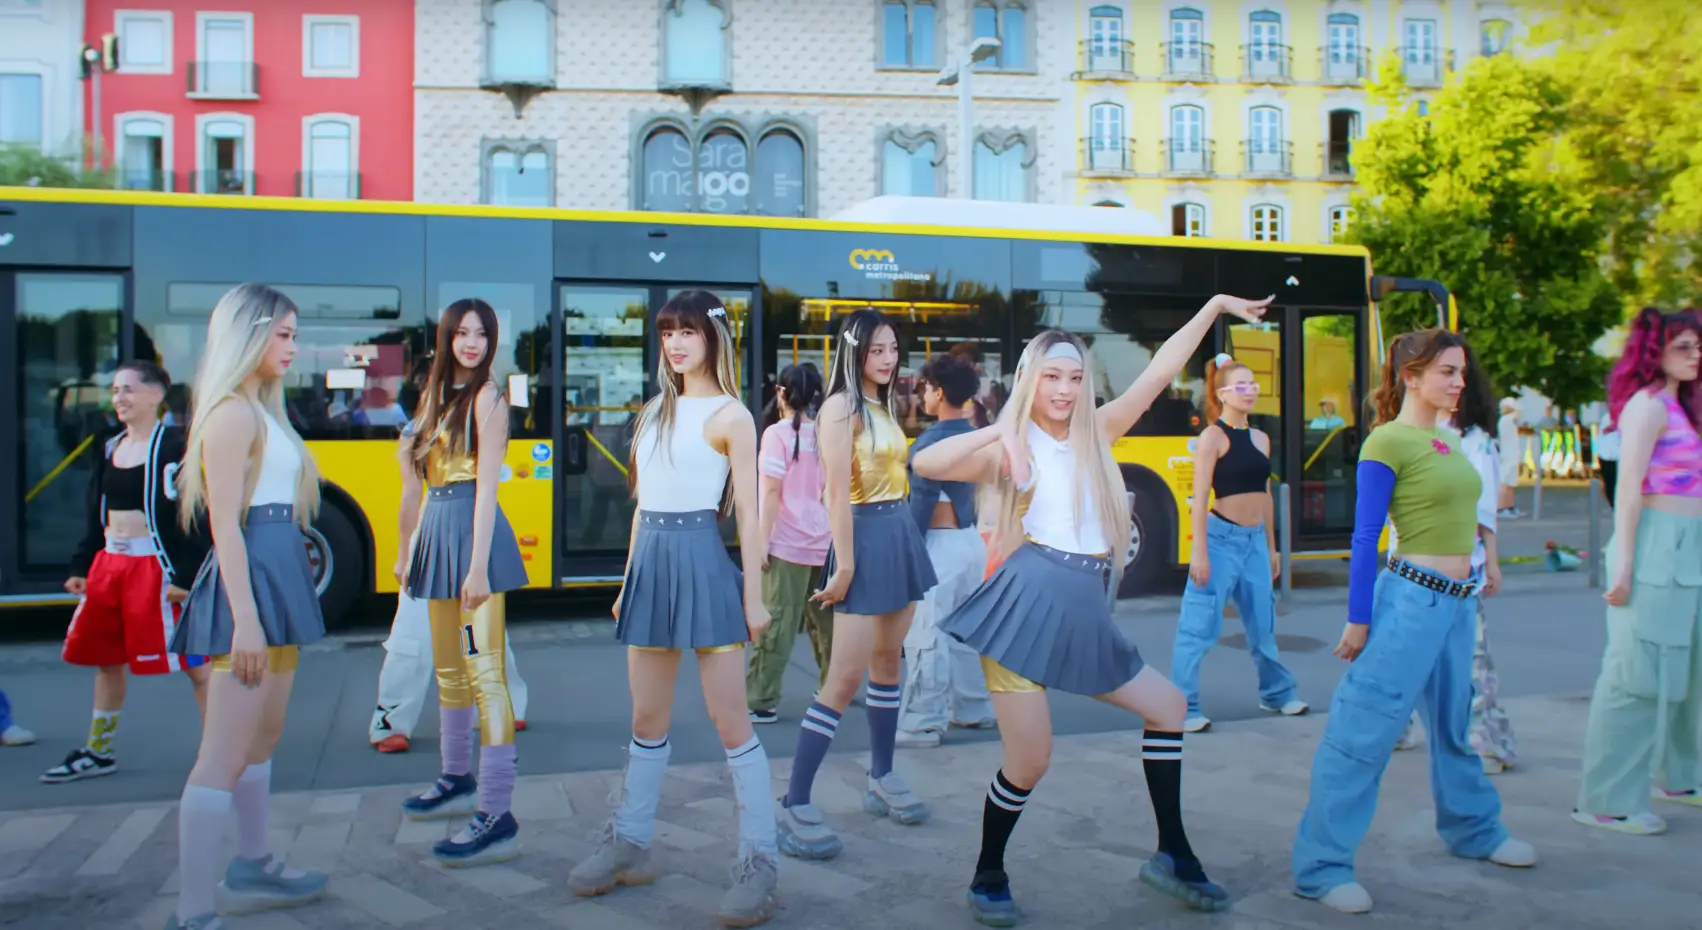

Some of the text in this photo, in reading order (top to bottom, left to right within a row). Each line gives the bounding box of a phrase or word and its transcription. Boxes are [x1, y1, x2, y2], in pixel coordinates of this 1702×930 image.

[672, 135, 746, 168] Sara
[865, 263, 898, 272] carris
[865, 271, 931, 281] metropolitana
